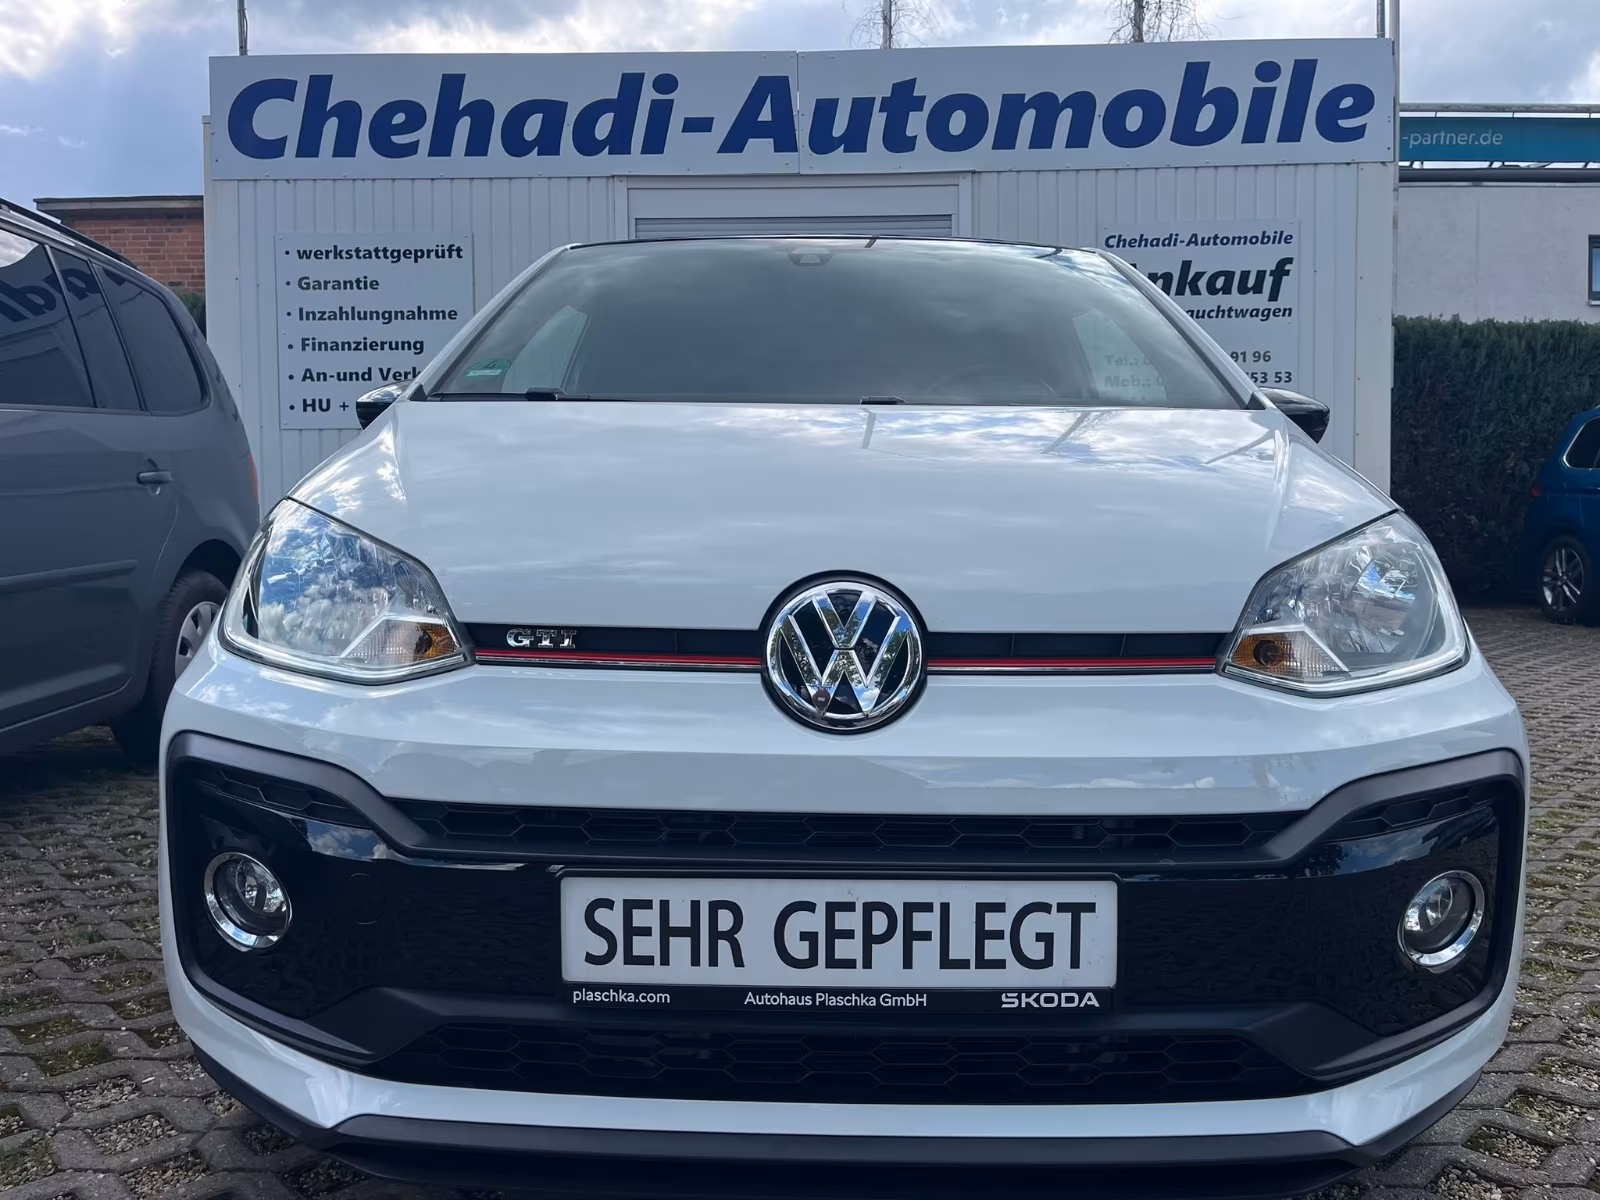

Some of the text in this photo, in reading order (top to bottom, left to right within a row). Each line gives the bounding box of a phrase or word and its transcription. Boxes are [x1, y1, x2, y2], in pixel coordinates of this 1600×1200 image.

[227, 58, 1375, 160] Chehadi-Automobile
[1402, 129, 1503, 149] -partner.de
[1104, 230, 1294, 249] Chehadi-Automobile
[296, 244, 463, 263] werkstattgeprüft
[297, 275, 380, 291] Garantie
[1131, 257, 1294, 302] nkauf
[298, 305, 458, 325] Inzahlungnahme
[301, 337, 425, 355] Finanzierung
[1230, 351, 1247, 363] 91
[1252, 350, 1272, 363] 96
[301, 367, 372, 382] An-und
[1245, 371, 1268, 384] 53
[1274, 371, 1293, 384] 53
[302, 398, 331, 413] HU
[506, 628, 577, 649] GTI
[584, 897, 1097, 970] SEHR GEPFLEGT
[572, 988, 671, 1004] plaschka.com
[744, 991, 927, 1007] Autohaus Plaschka GmbH
